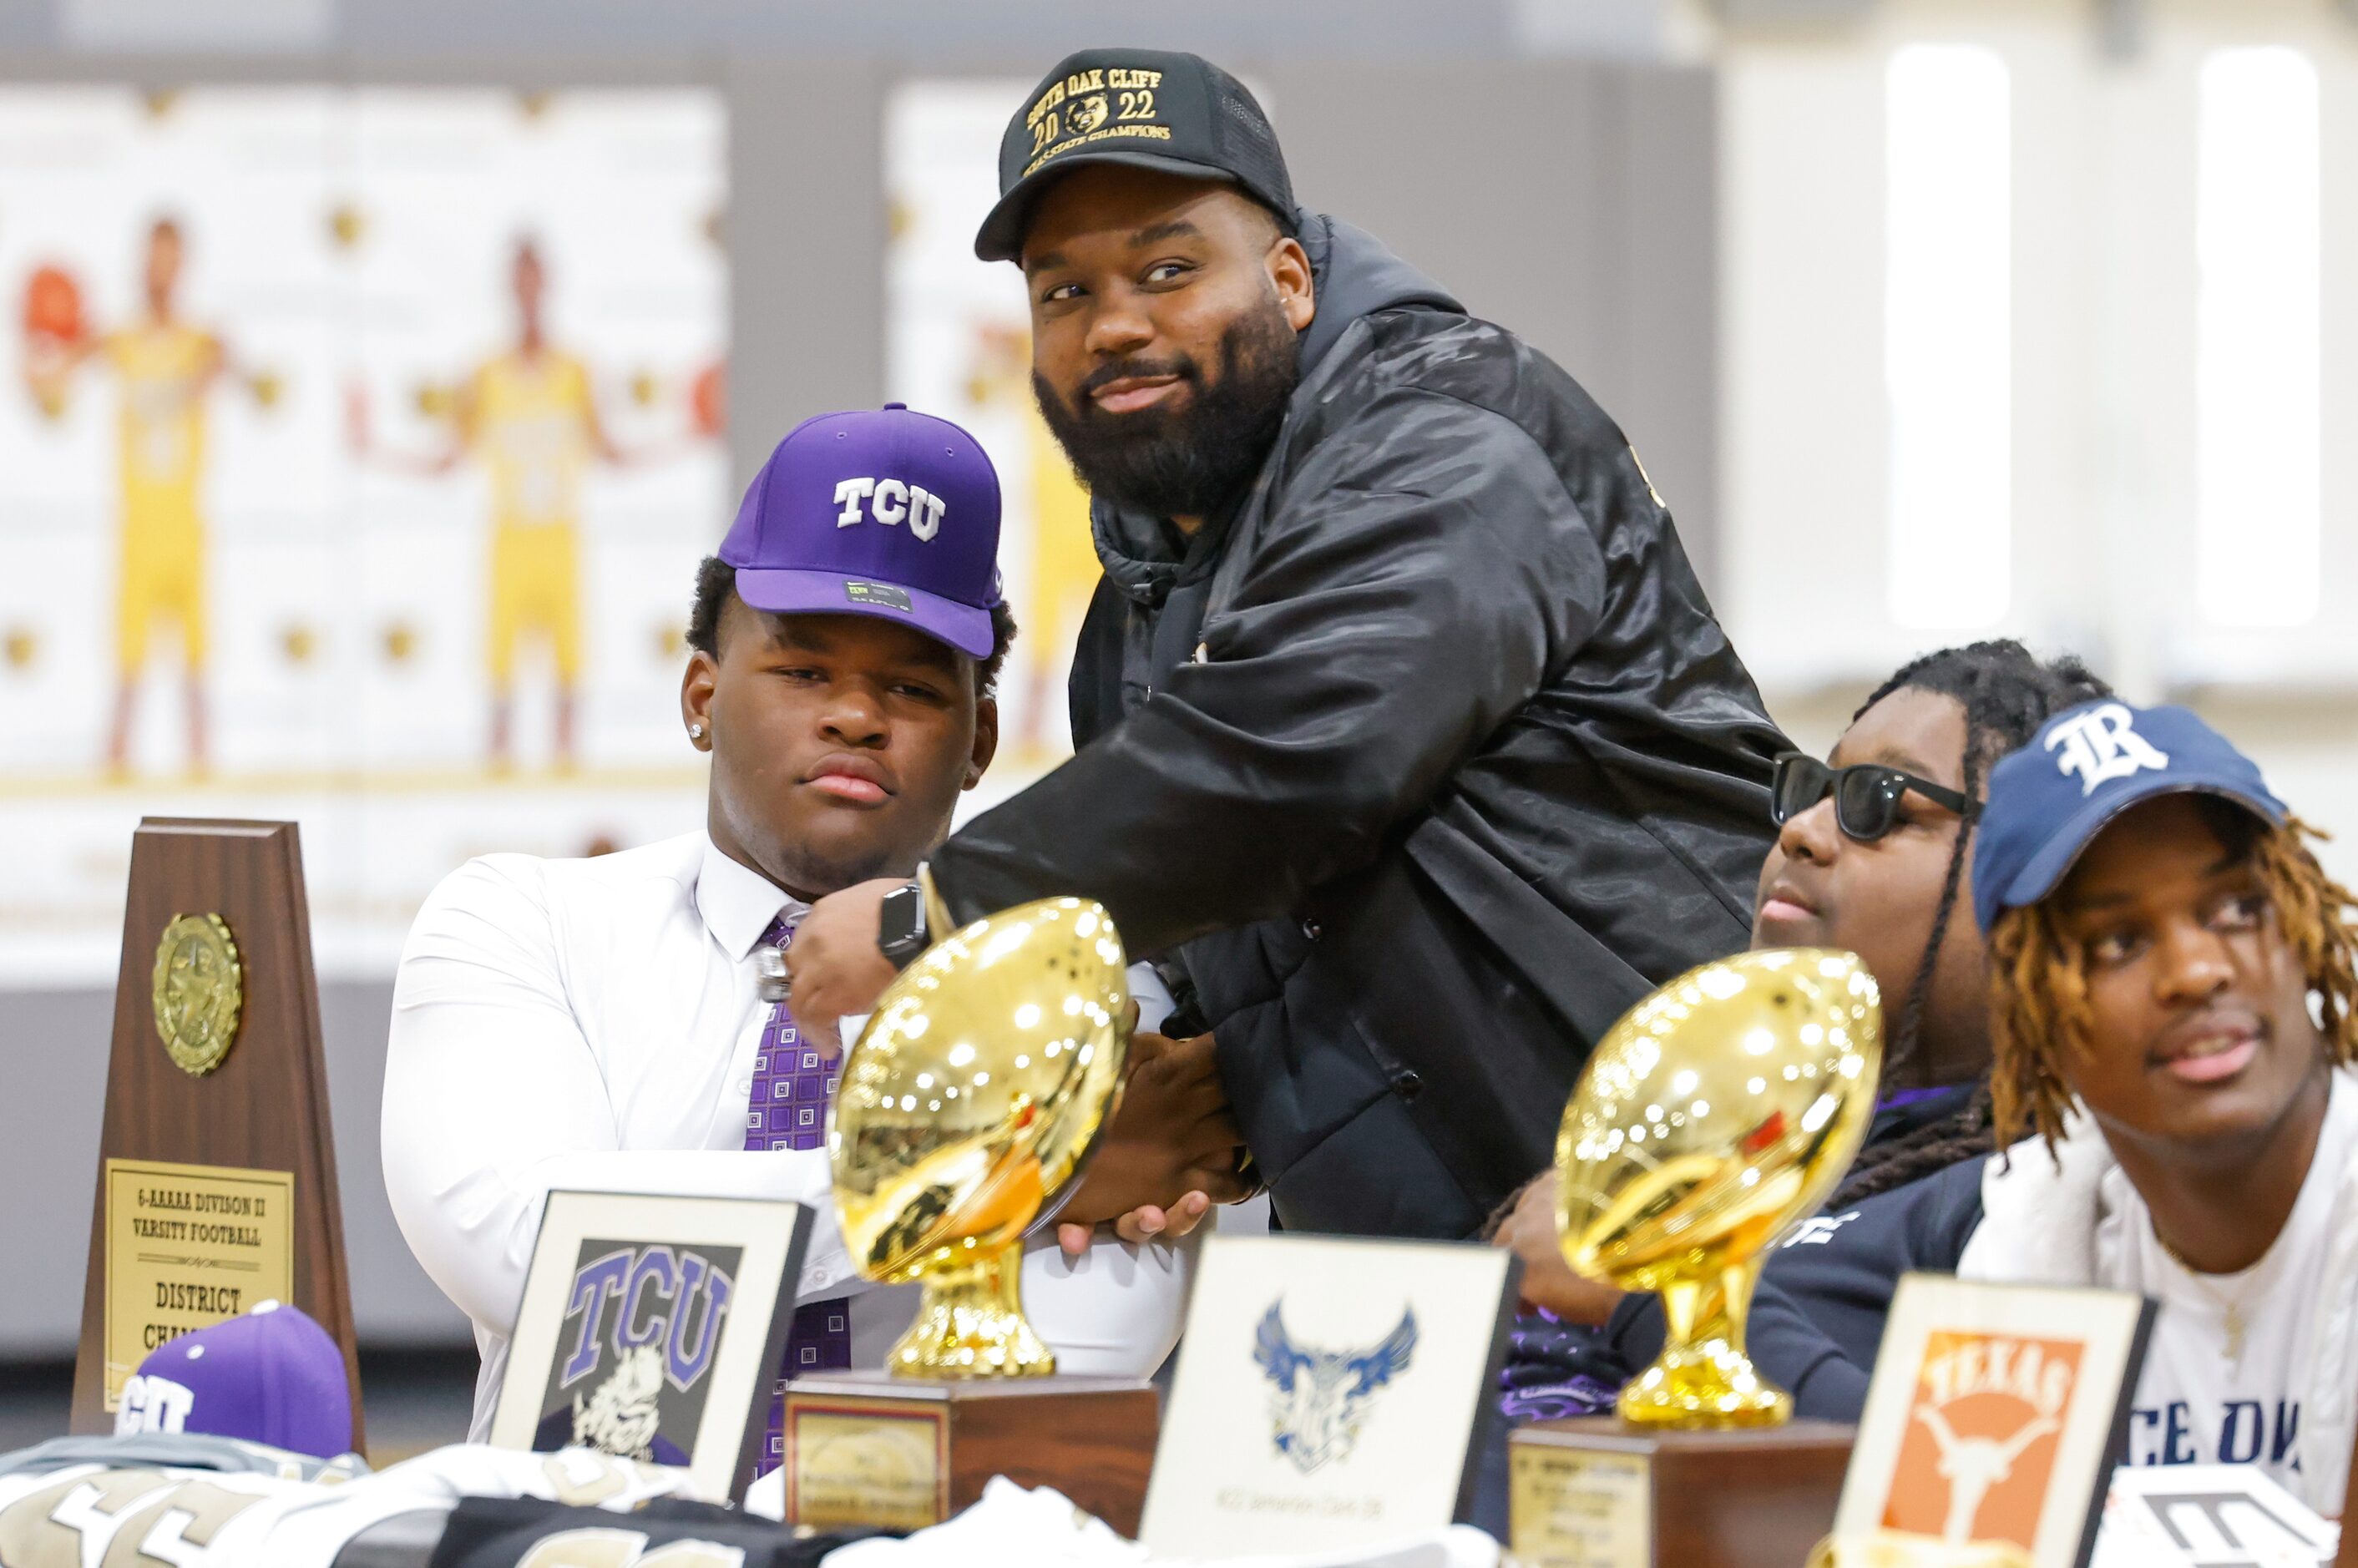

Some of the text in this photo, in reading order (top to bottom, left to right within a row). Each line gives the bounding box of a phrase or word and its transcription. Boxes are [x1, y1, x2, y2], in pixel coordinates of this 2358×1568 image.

[1026, 68, 1163, 131] SOUTH OAK CLIFF
[1030, 89, 1156, 157] 20 22
[1088, 124, 1171, 141] CHAMPIONS
[833, 477, 947, 543] TCU
[2043, 702, 2169, 797] R
[133, 1217, 262, 1247] VARSITY FOOTBALL
[155, 1281, 241, 1315] DISTRICT
[559, 1244, 735, 1394] TCU
[1922, 1338, 2073, 1417] TEXAS
